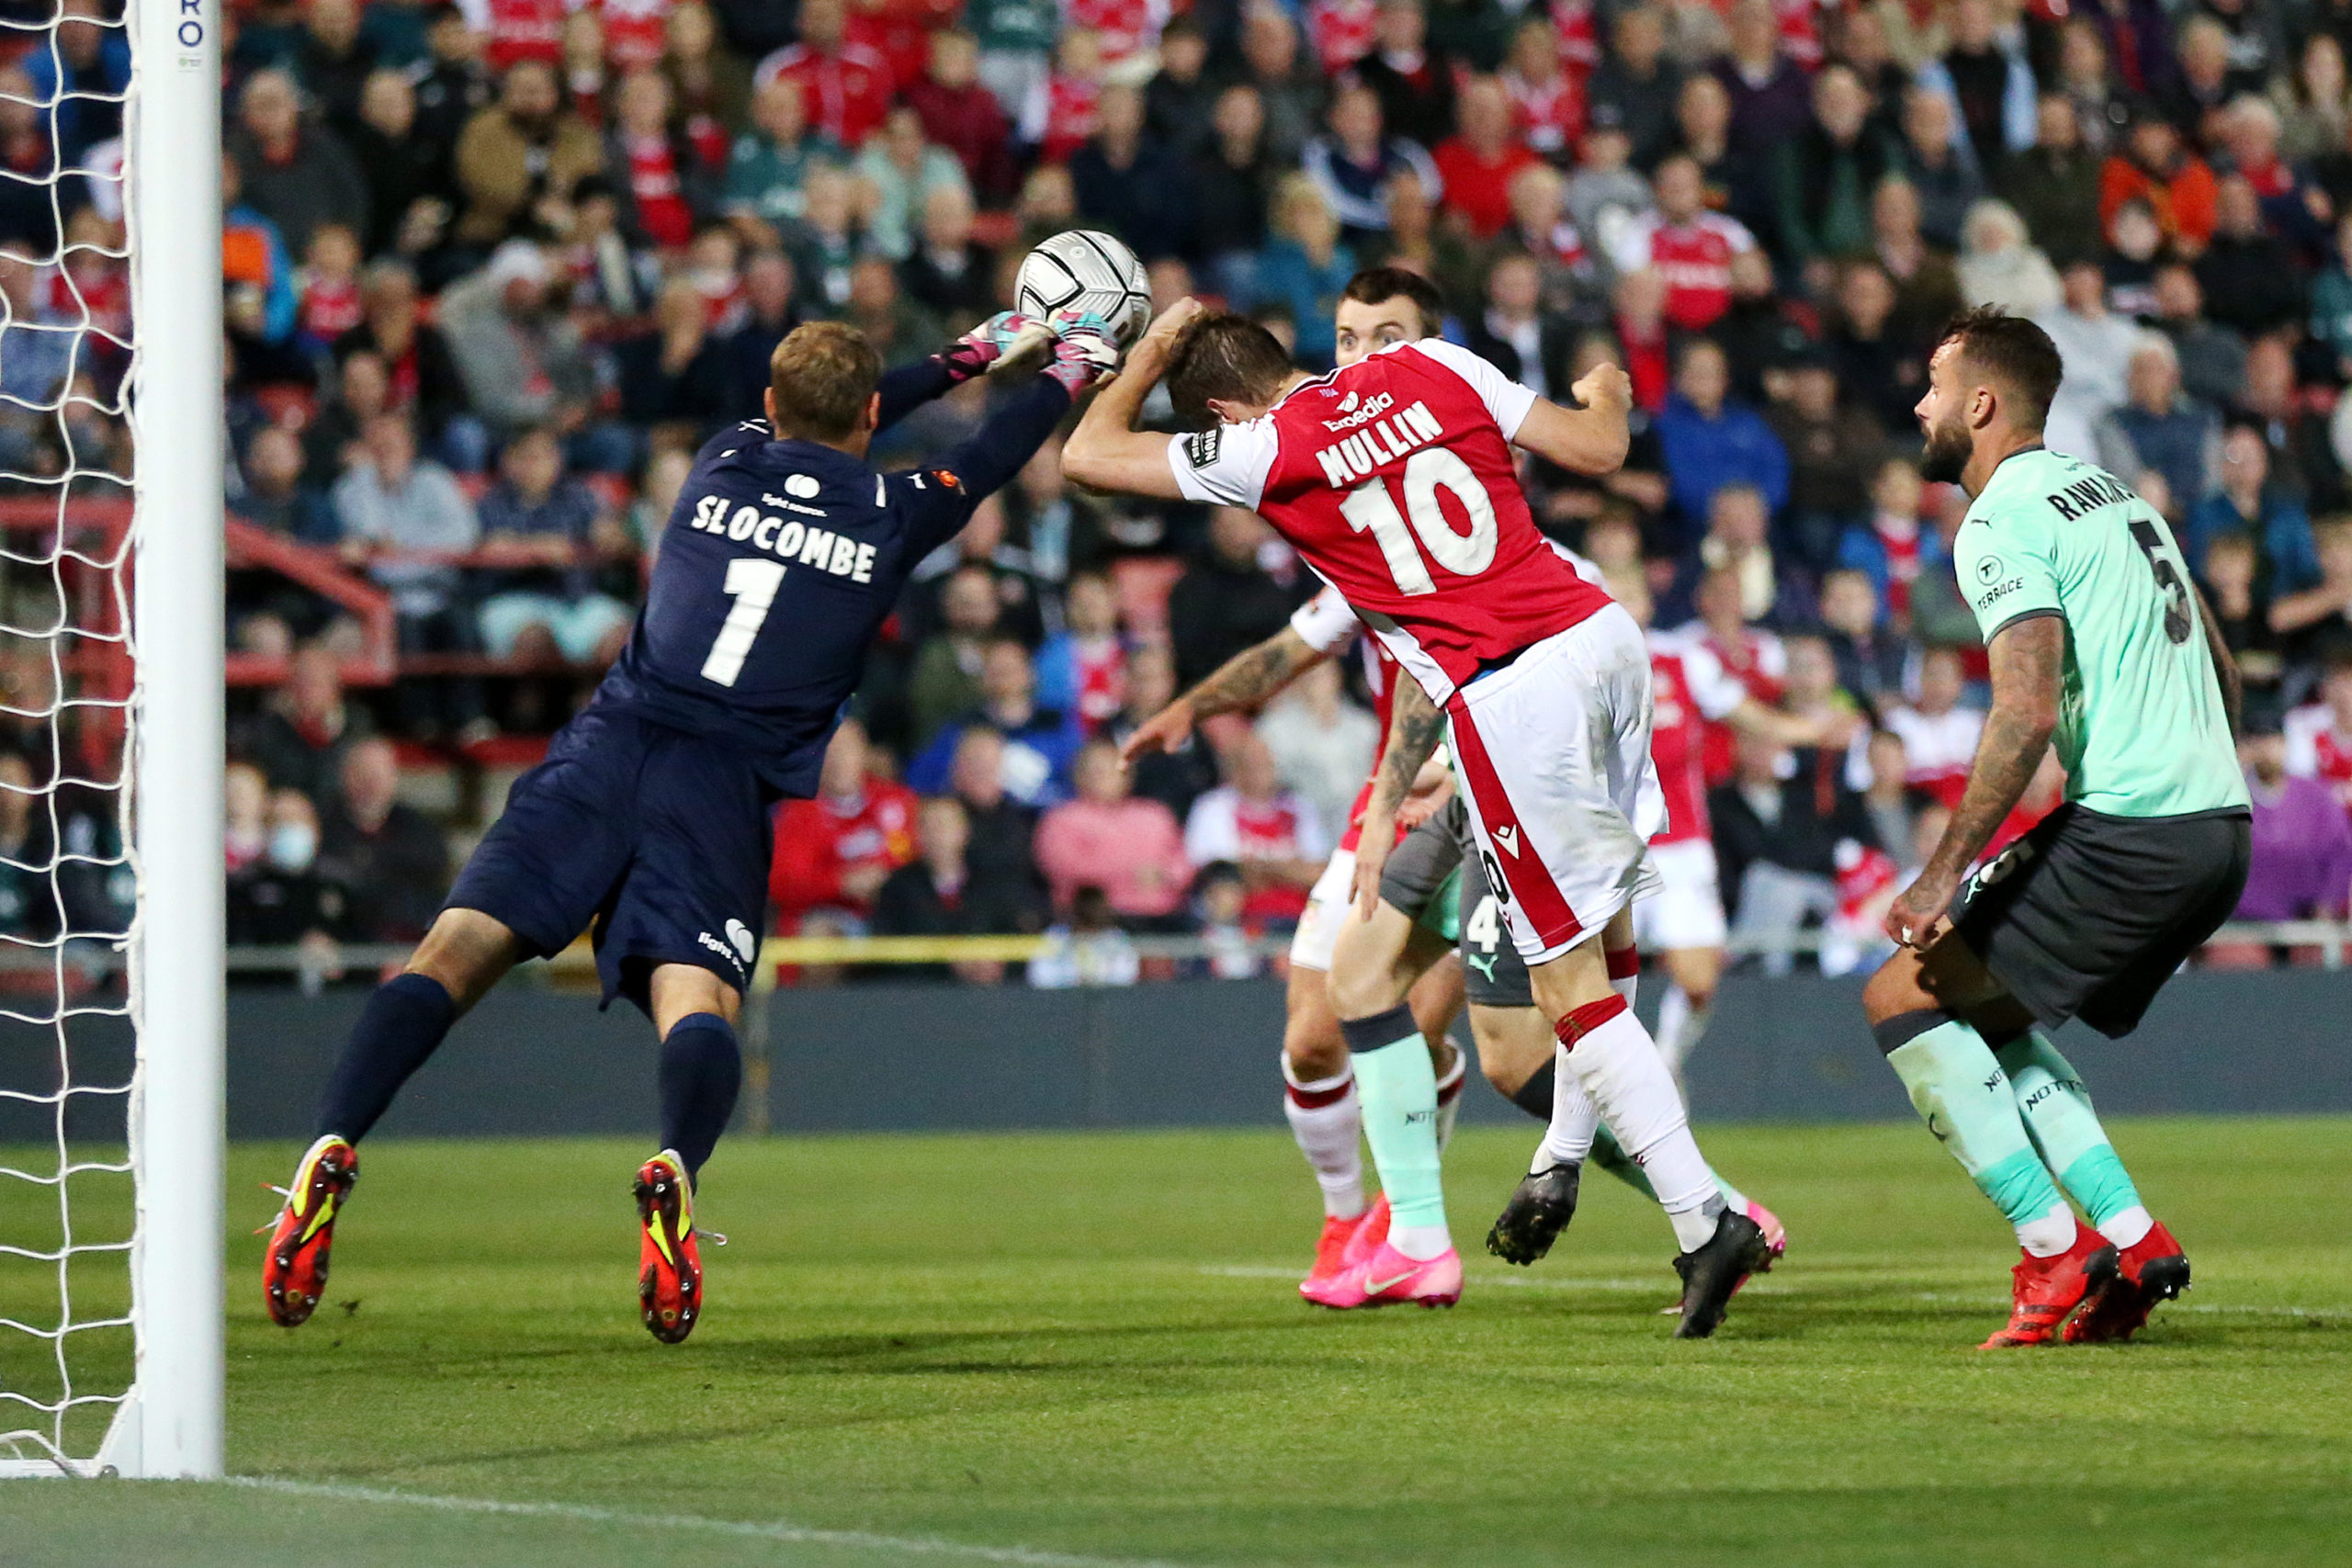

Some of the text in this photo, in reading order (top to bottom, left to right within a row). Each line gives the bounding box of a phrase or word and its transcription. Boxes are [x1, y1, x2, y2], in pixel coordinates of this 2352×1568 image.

[1316, 400, 1443, 489] MULLIN
[691, 495, 877, 584] SLOCOMBE
[1338, 446, 1498, 596] 10
[701, 558, 787, 688] 1
[1977, 576, 2024, 613] TERRACE
[2127, 519, 2192, 645] 5
[1467, 895, 1500, 953] 4
